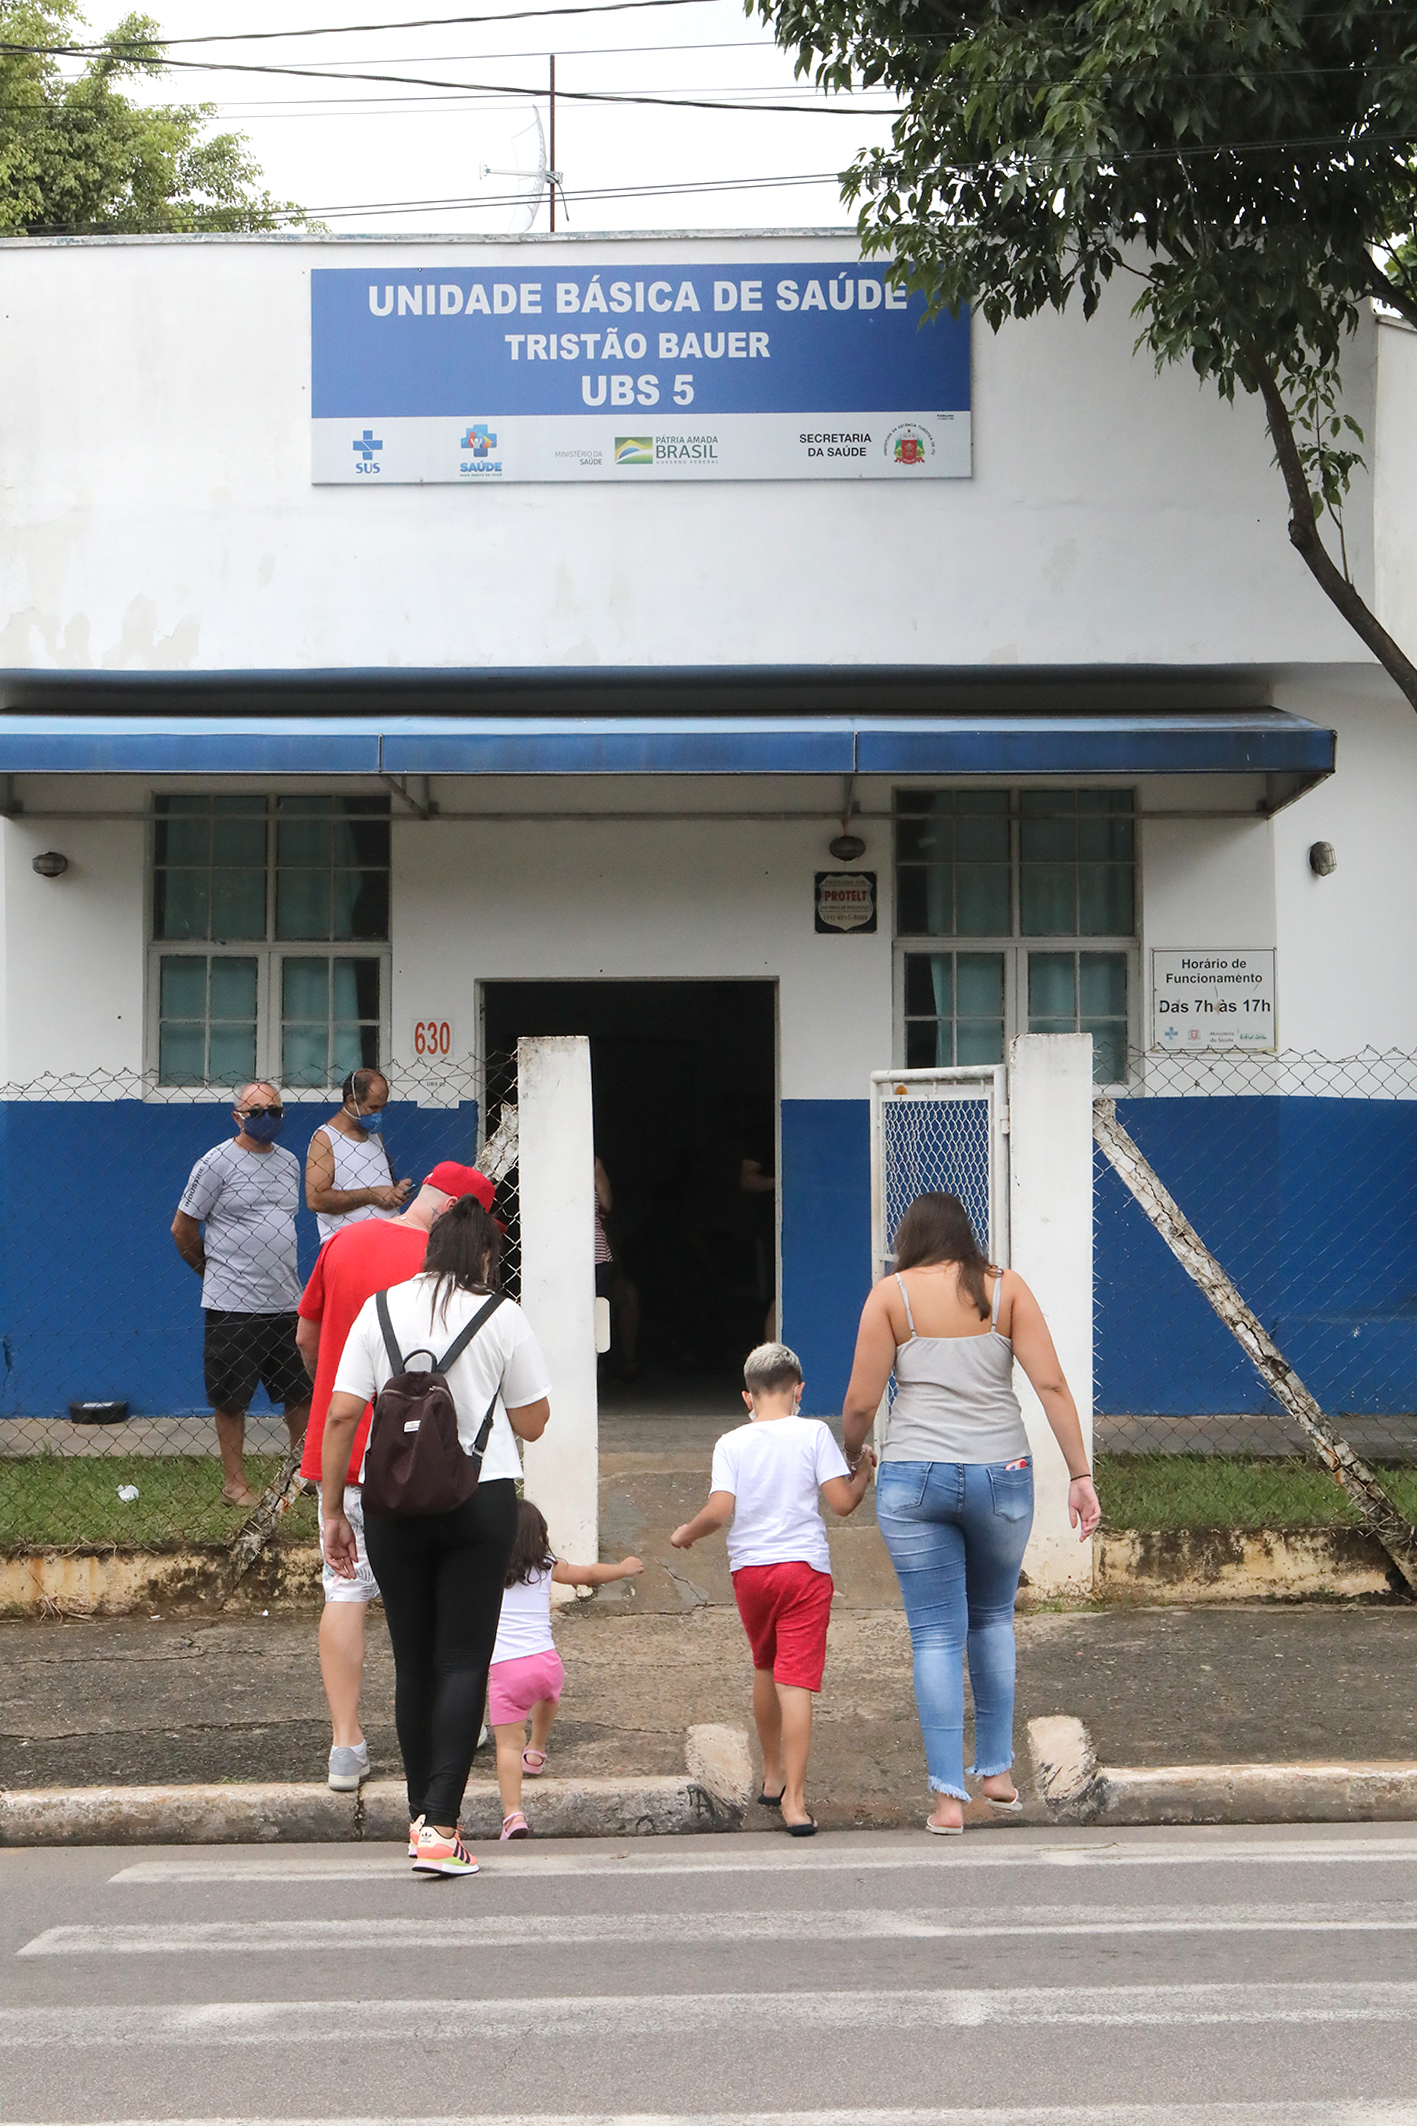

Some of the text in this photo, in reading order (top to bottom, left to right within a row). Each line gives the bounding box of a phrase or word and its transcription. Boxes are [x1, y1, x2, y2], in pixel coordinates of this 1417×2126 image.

[368, 271, 908, 317] UNIDADE BÁSICA DE SAÚDE
[504, 327, 771, 361] TRISTÃO BAUER
[581, 373, 696, 407] UBS 5
[655, 434, 719, 444] PÁTRIA AMADA
[799, 433, 873, 444] SECRETARIA
[554, 449, 603, 458] MINISTÉRIO DA
[655, 444, 719, 459] BRASIL
[807, 445, 867, 457] DA SAÚDE
[459, 460, 503, 473] SAÚDE
[579, 457, 603, 466] SAÚDE
[355, 462, 381, 474] SUS
[824, 889, 868, 902] PROTELT
[1181, 958, 1247, 969] Horário de
[1165, 973, 1263, 984] Funcionamento
[1159, 999, 1271, 1013] Das 7h às 17h
[414, 1022, 451, 1055] 630
